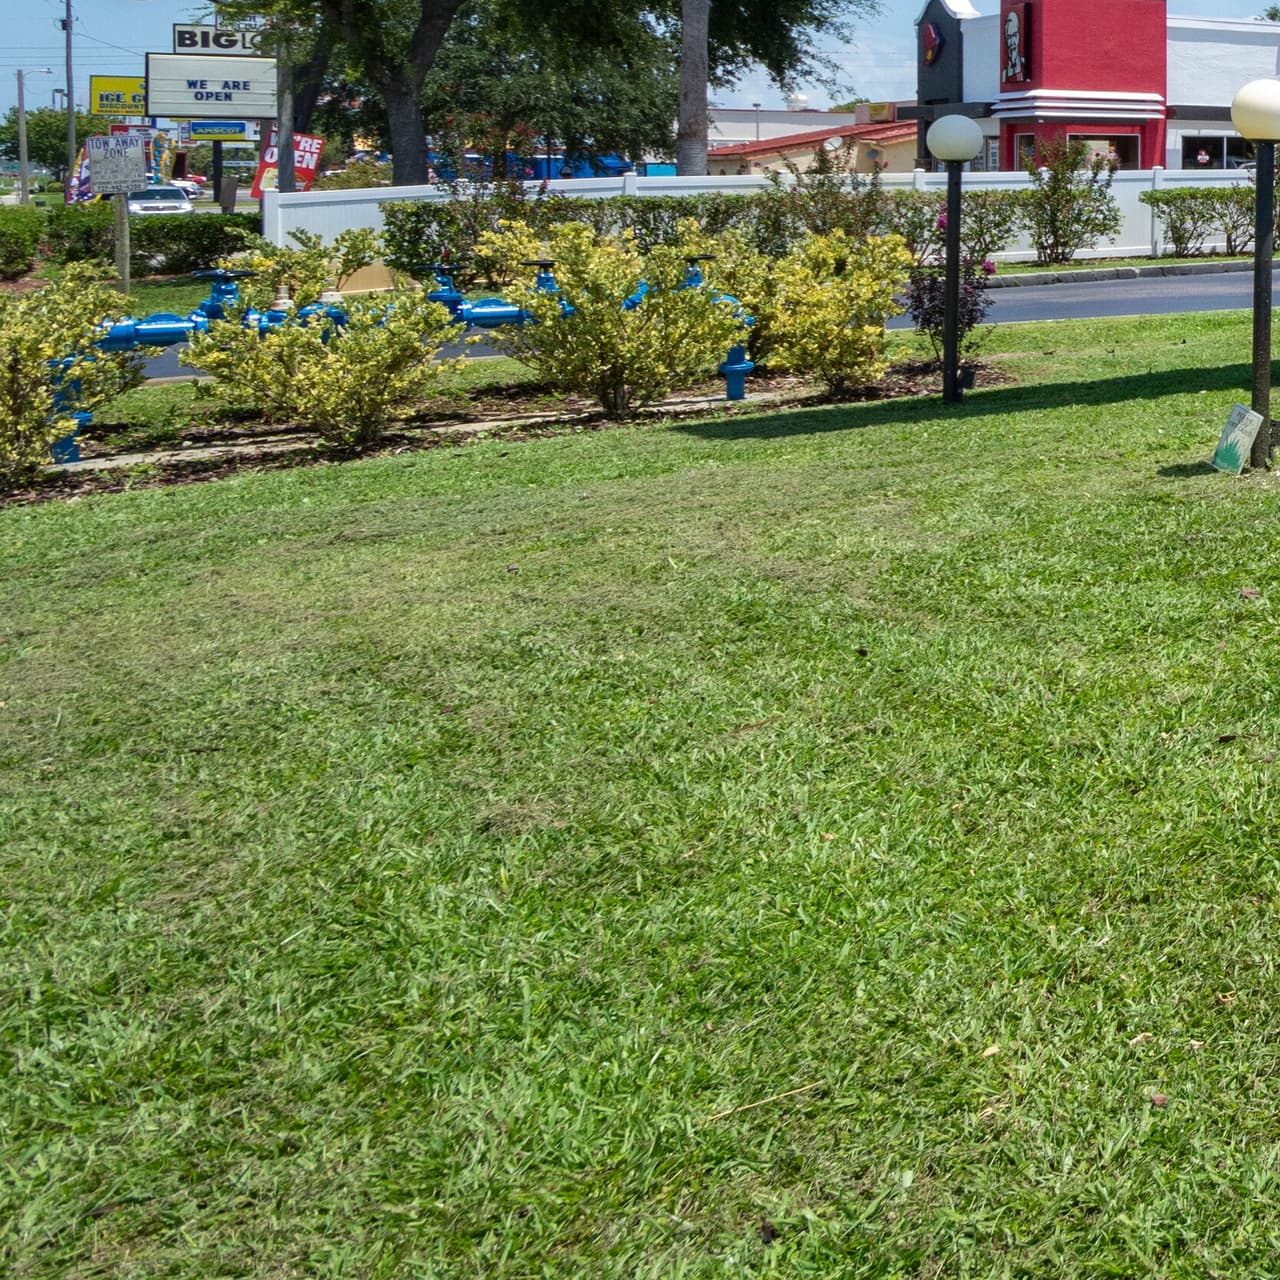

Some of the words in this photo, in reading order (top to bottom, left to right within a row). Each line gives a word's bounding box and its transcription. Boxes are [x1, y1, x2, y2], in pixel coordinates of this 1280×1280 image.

[177, 30, 238, 49] BIG
[186, 79, 208, 90] WE
[221, 80, 251, 91] ARE
[194, 91, 233, 102] OPEN
[89, 138, 110, 150] TOW
[115, 137, 140, 148] AWAY
[103, 147, 129, 160] ZONE
[264, 147, 318, 169] OEN
